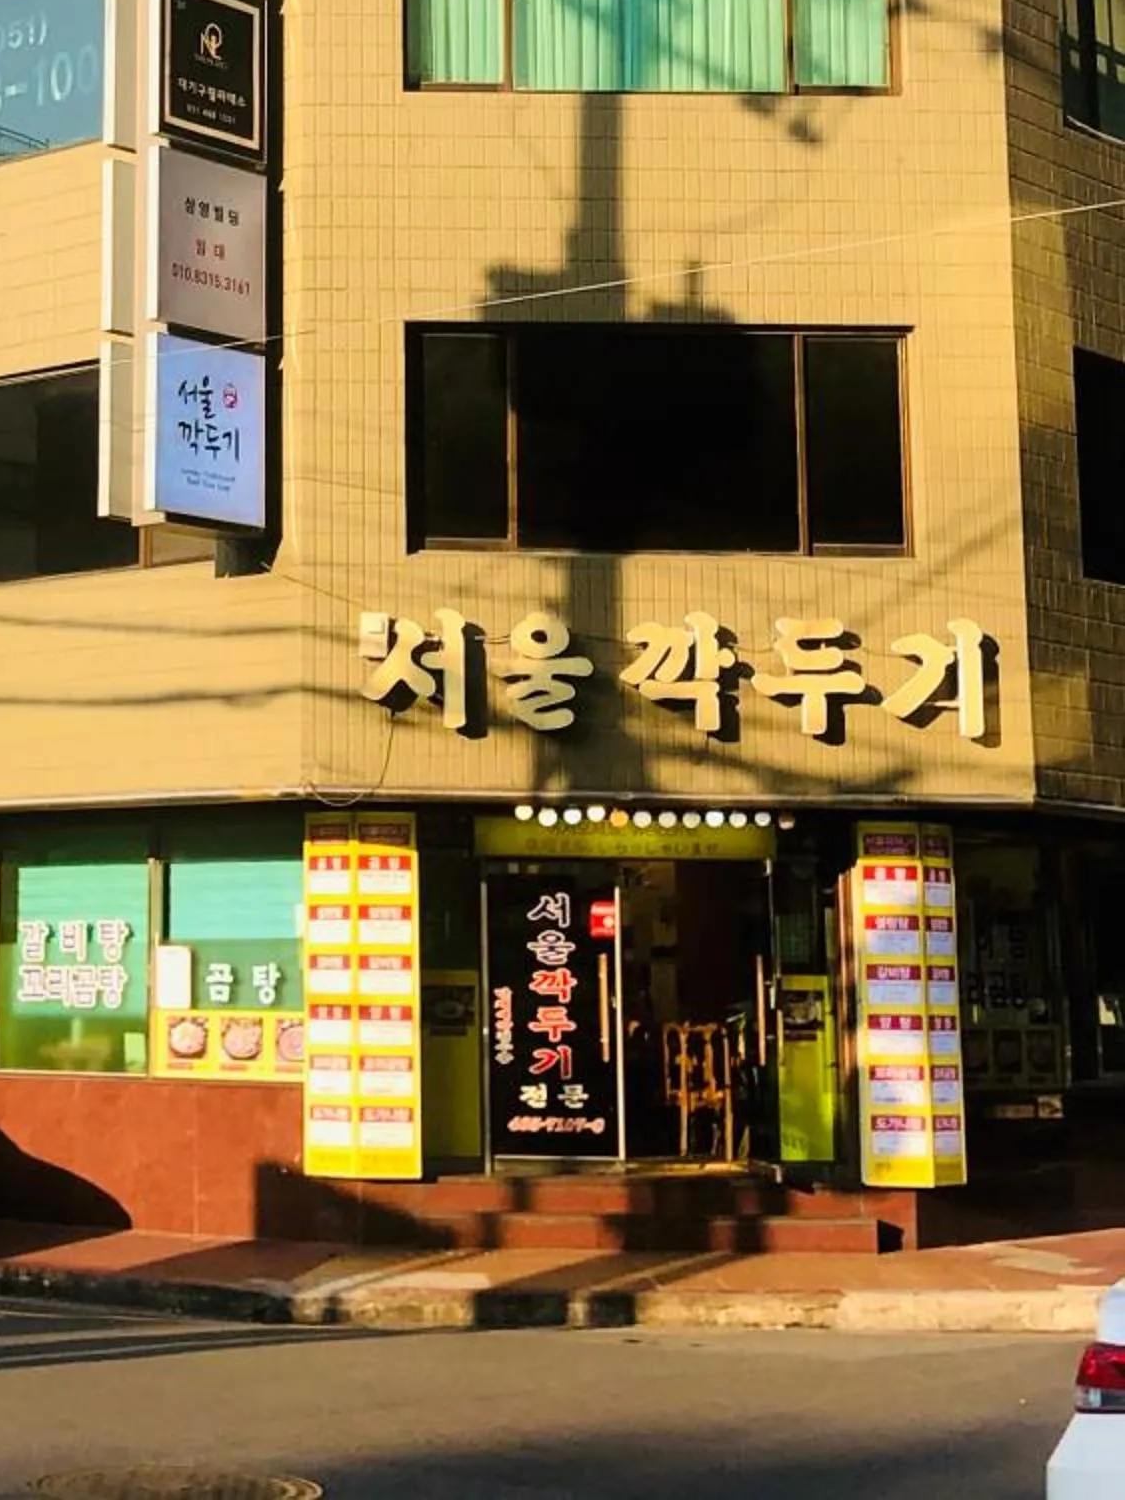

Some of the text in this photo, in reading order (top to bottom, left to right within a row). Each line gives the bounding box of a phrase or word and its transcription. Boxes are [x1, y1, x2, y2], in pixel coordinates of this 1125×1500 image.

[178, 375, 216, 420] 서울
[178, 420, 239, 463] 깍두기
[359, 608, 985, 739] 서울깍두기
[19, 920, 131, 962] 갈비탕
[205, 962, 282, 1005] 곰탕
